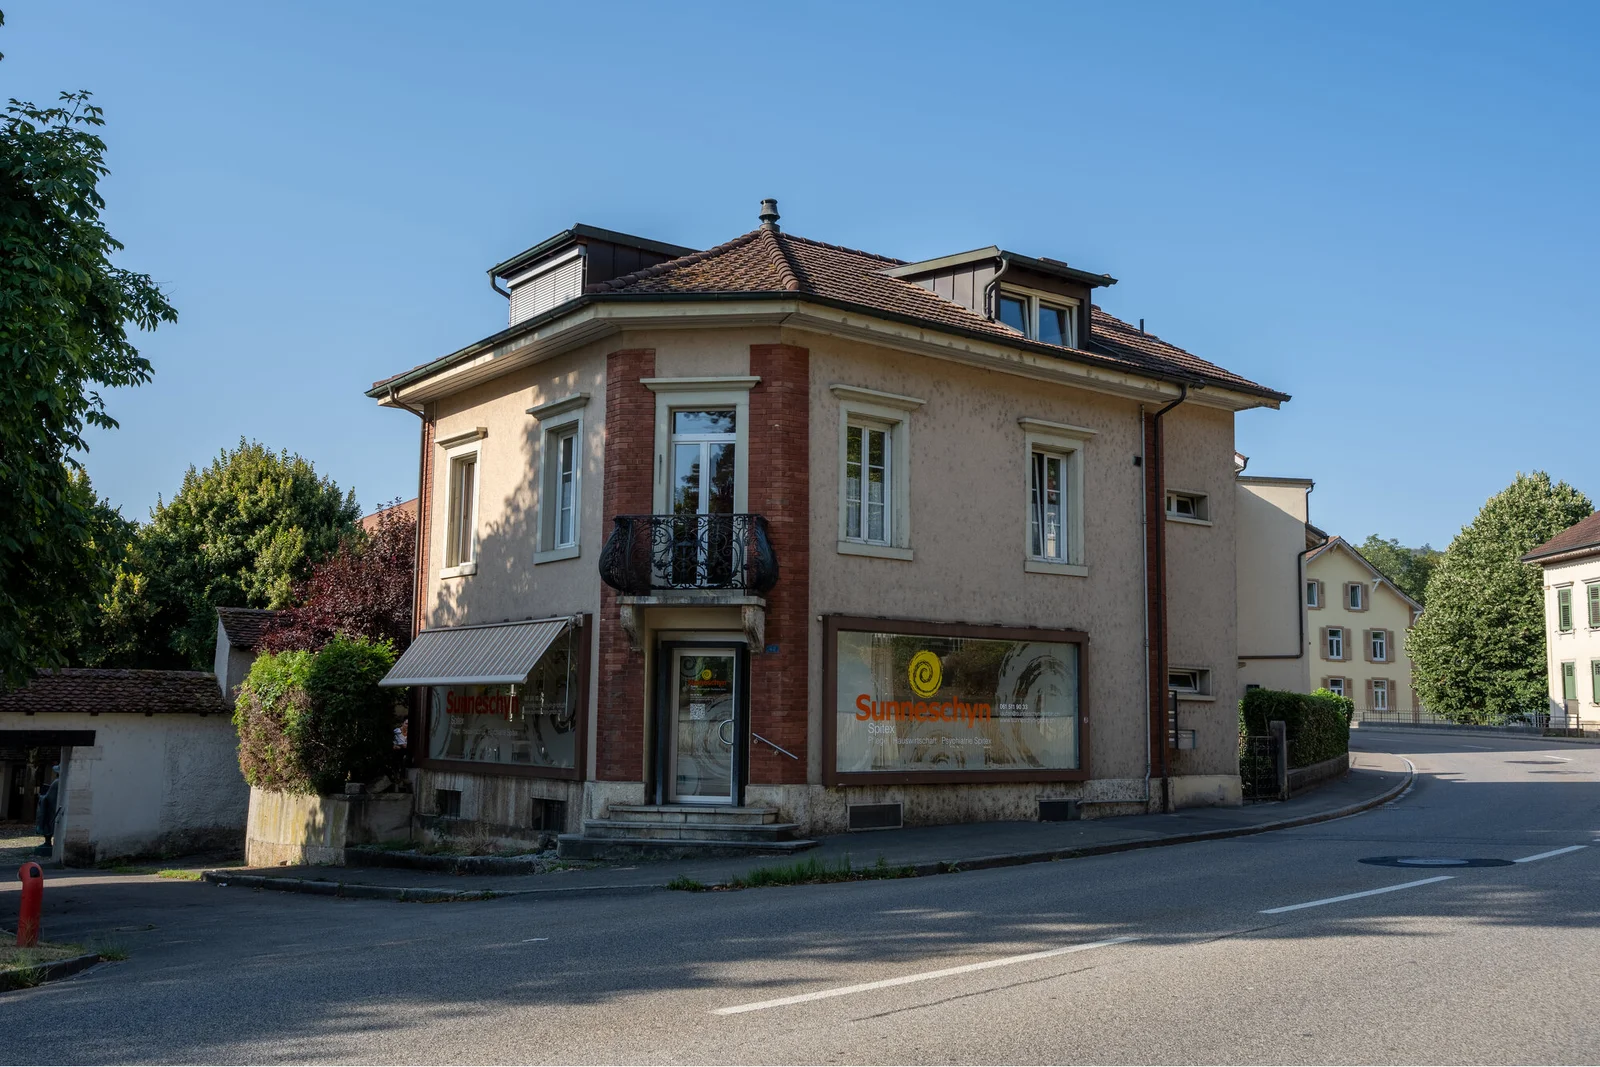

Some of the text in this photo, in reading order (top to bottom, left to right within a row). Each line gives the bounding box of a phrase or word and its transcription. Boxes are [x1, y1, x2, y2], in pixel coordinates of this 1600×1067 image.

[446, 690, 519, 720] Sunneschyn
[855, 694, 991, 729] Sunneschyn
[868, 722, 895, 736] Spitex
